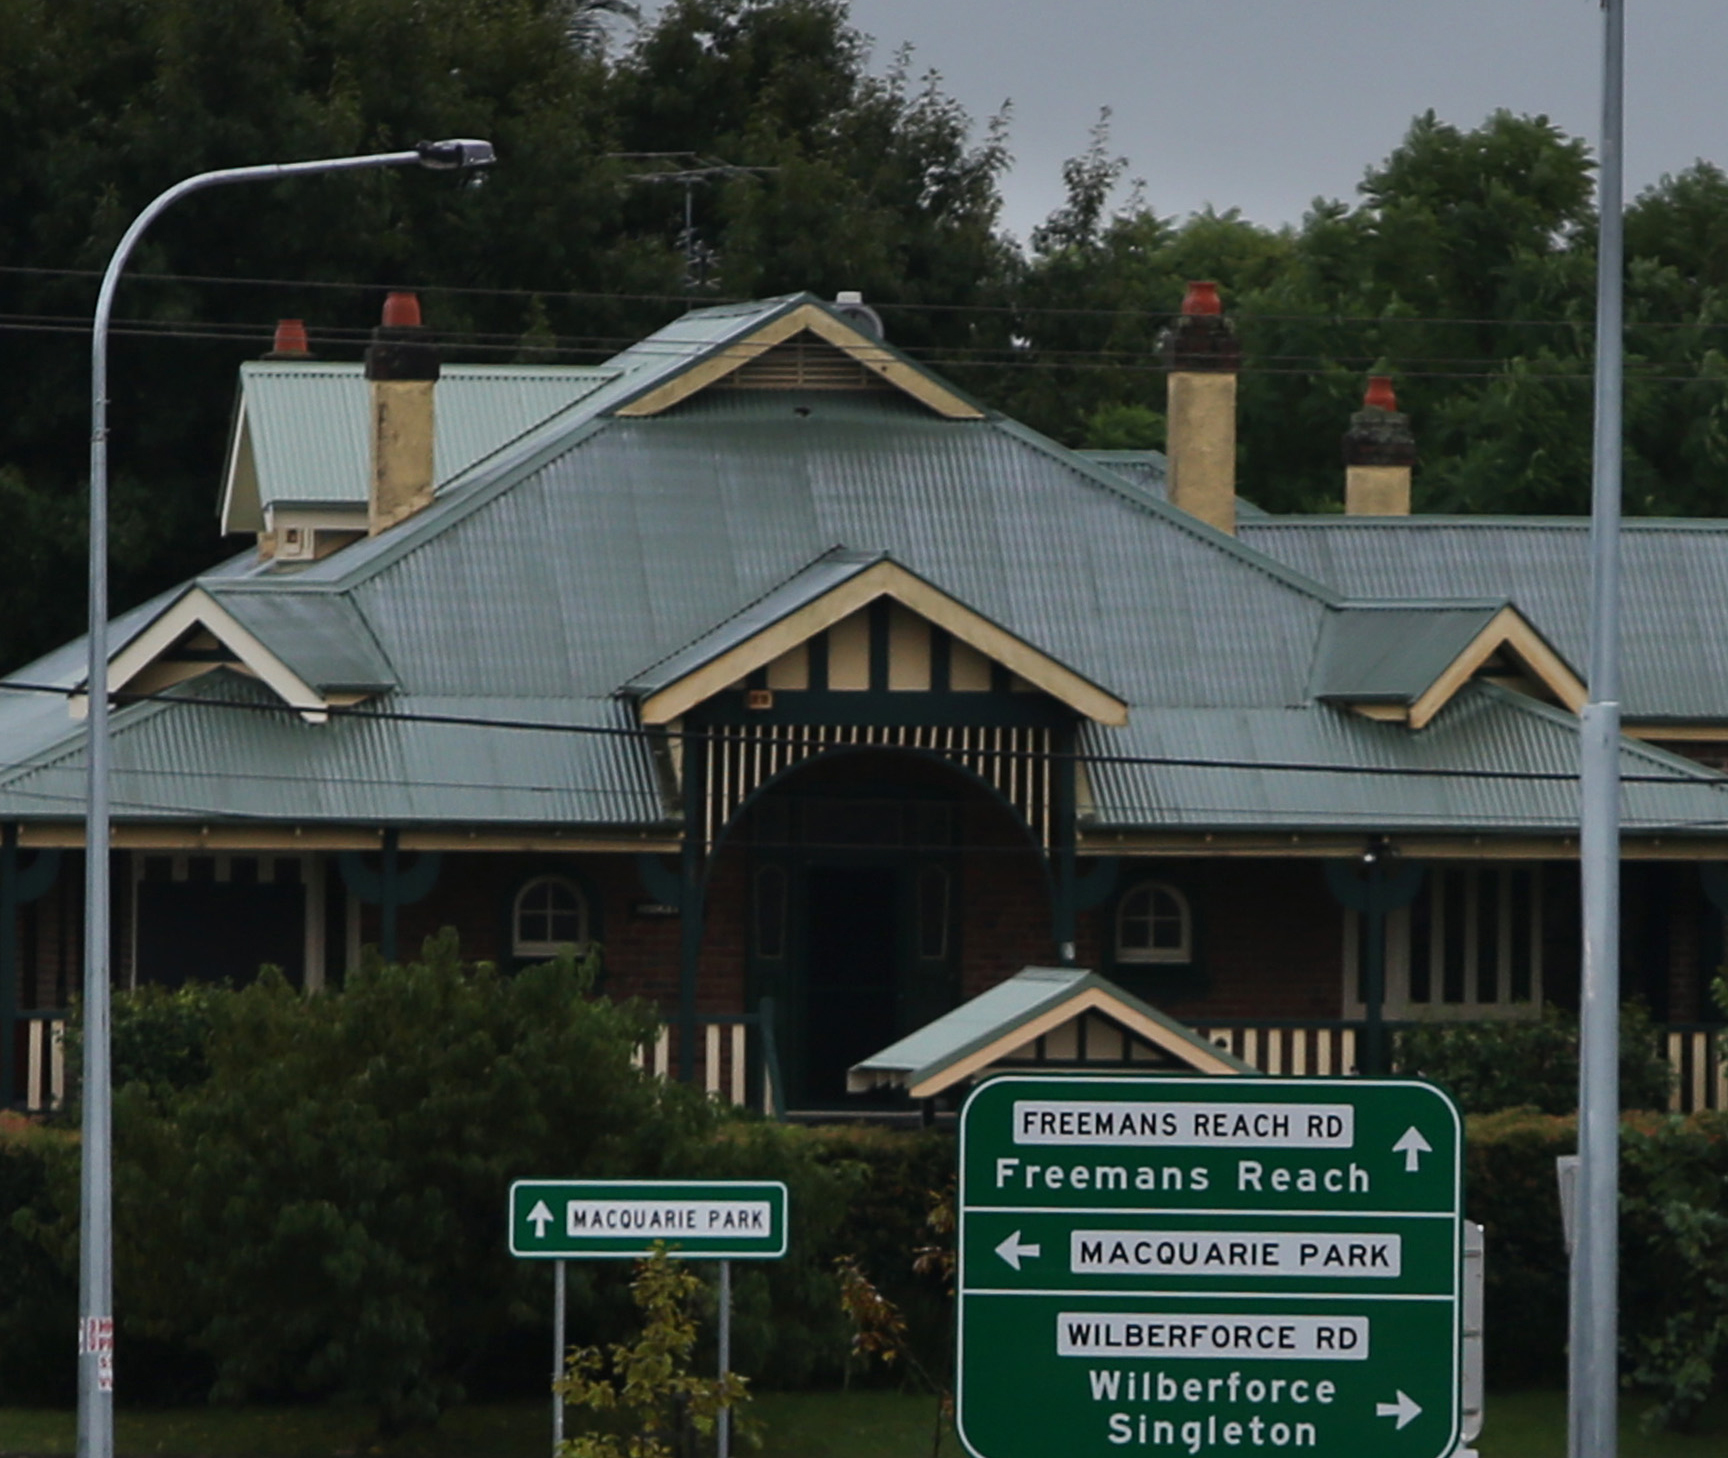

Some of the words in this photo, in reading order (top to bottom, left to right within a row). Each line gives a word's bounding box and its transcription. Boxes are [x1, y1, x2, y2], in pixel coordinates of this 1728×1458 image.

[1023, 1111, 1177, 1137] FREEMANS
[1194, 1113, 1289, 1138] REACH
[1307, 1114, 1343, 1138] RD
[996, 1158, 1209, 1190] Freemans
[1238, 1160, 1369, 1193] Reach
[573, 1209, 696, 1229] MACQUARIE
[708, 1209, 762, 1228] PARK
[1080, 1241, 1280, 1266] MACQUARIE
[1300, 1243, 1389, 1267] PARK
[1068, 1323, 1296, 1350] WILBERFORCE
[1316, 1326, 1358, 1350] RD
[1089, 1370, 1336, 1404] Wilberforce
[1108, 1412, 1316, 1454] Singleton
